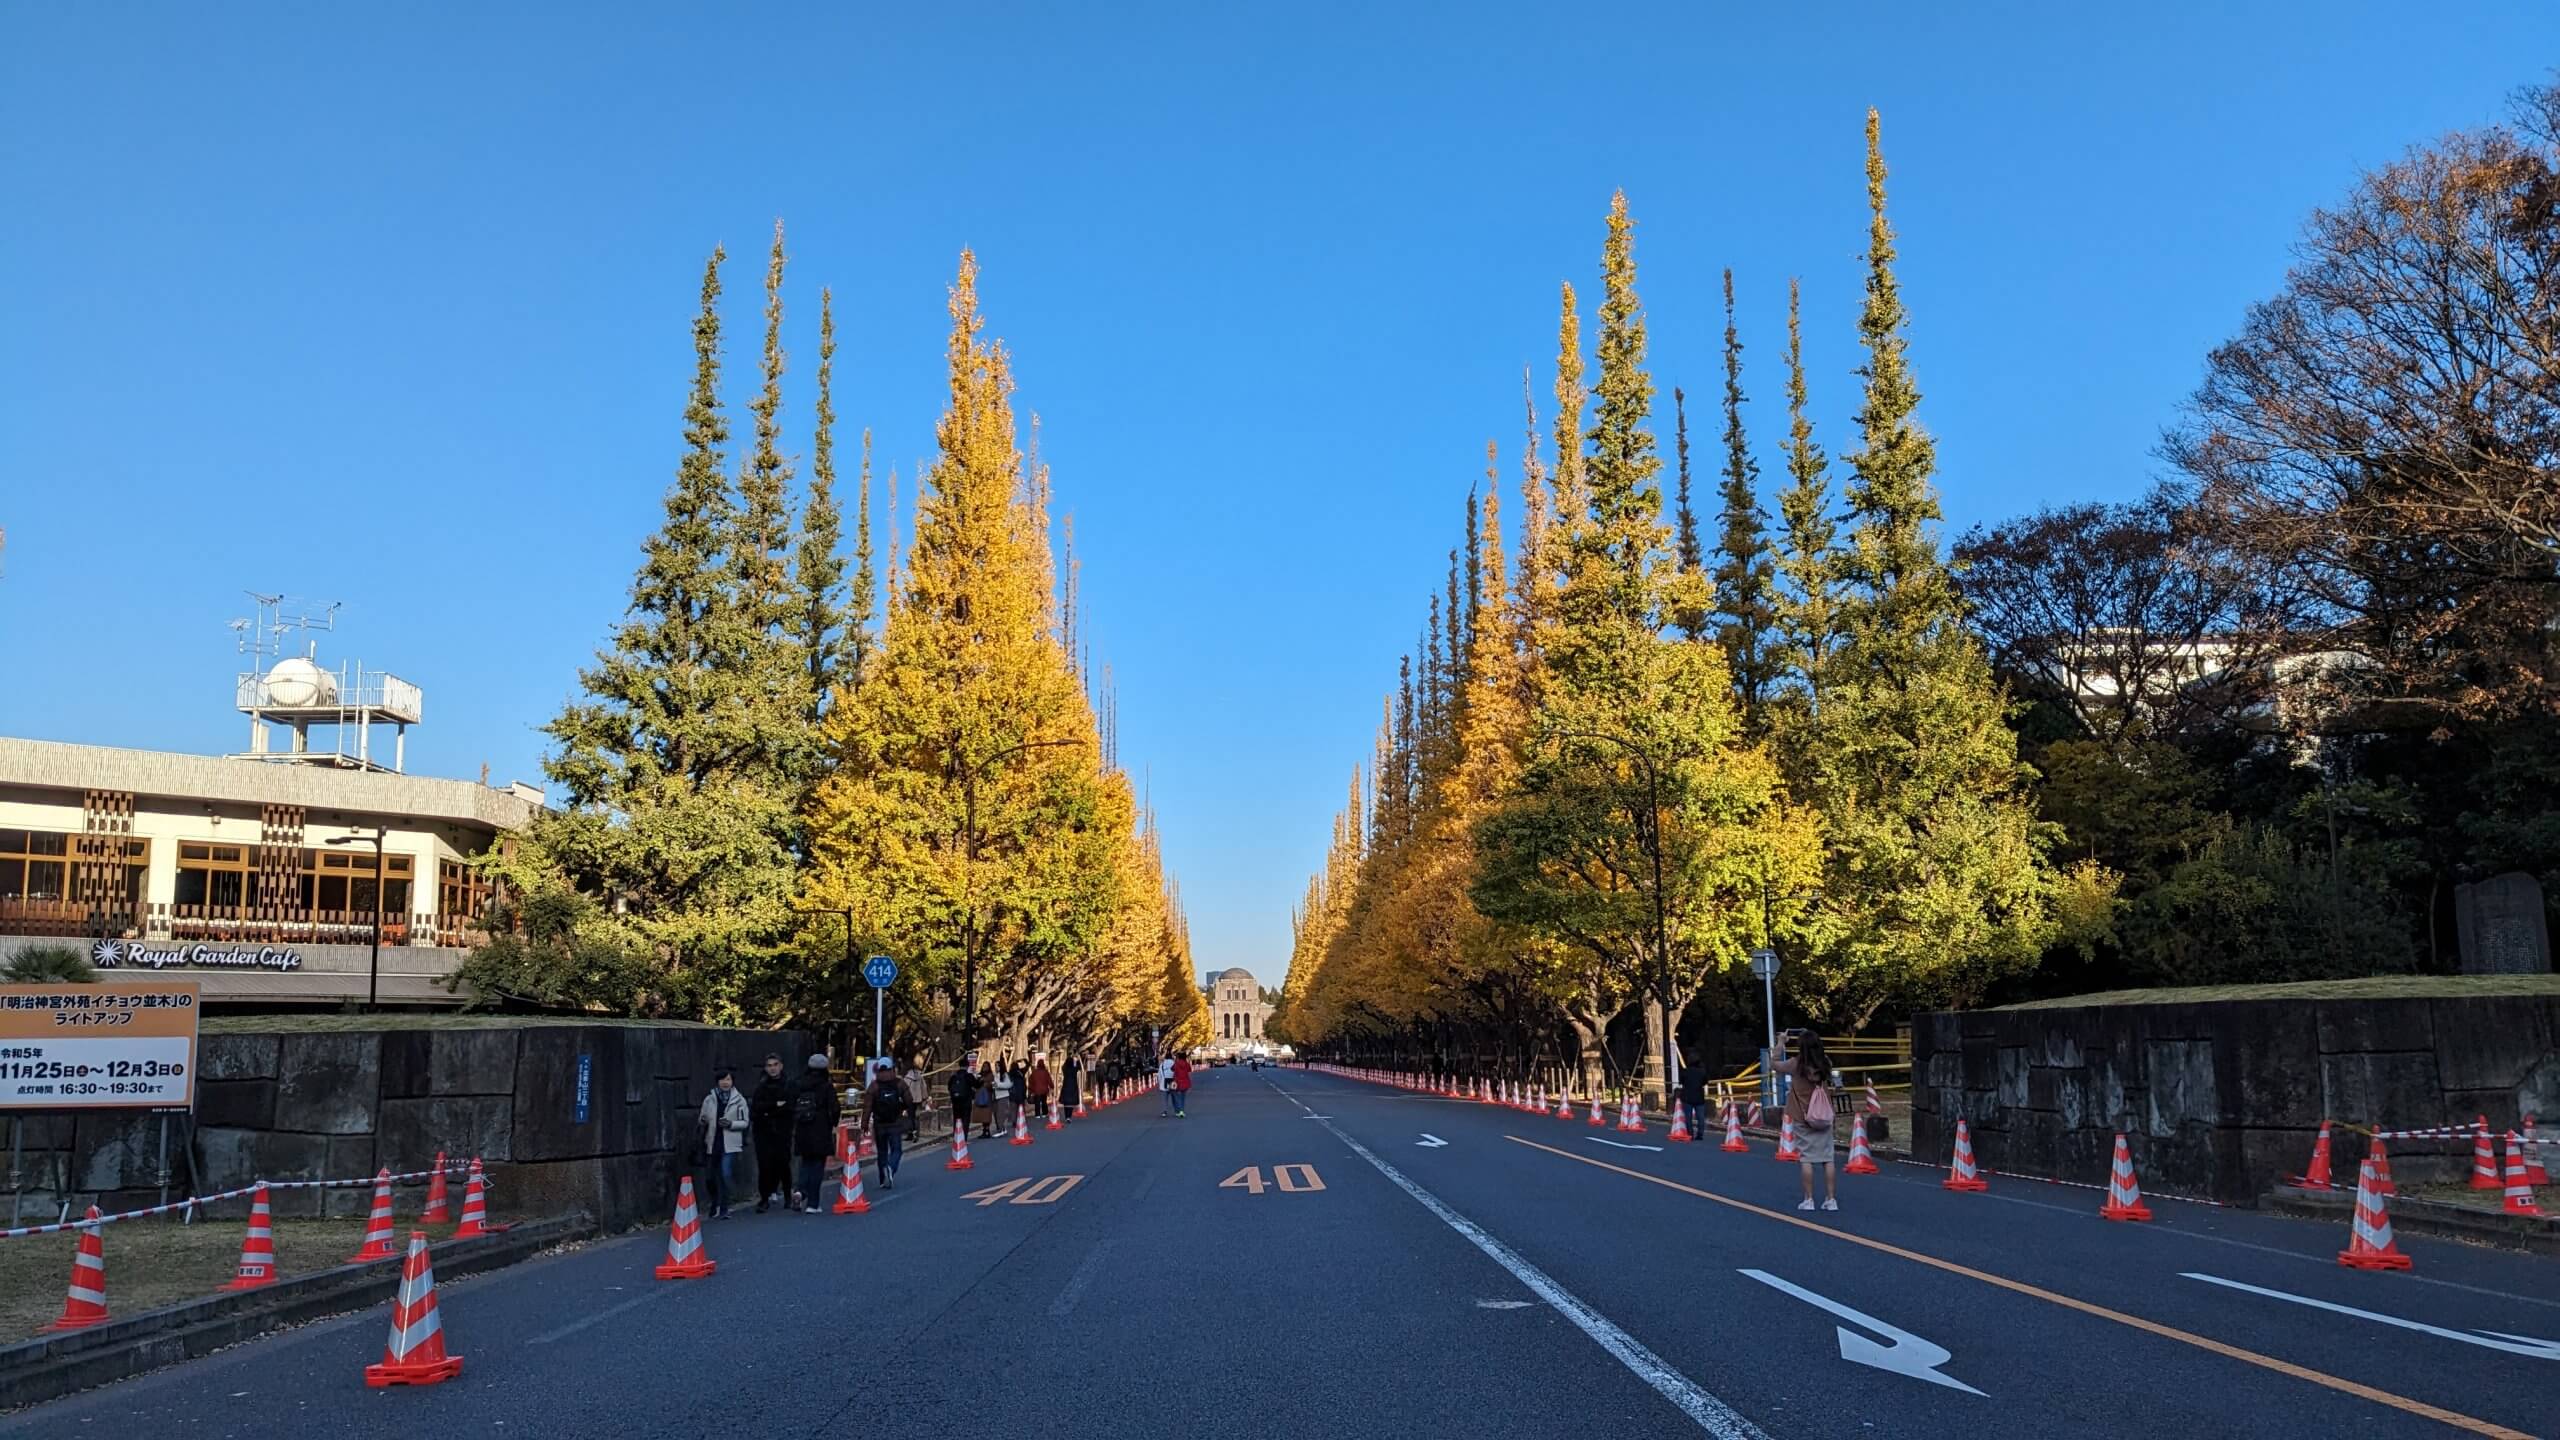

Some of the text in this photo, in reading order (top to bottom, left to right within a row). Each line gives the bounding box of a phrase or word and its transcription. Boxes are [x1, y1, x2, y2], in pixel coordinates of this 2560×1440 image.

[127, 943, 301, 970] Royal Garden Cafe
[869, 965, 892, 977] 414
[0, 994, 192, 1010] 「明治神宮外苑イチョウ並木」の
[55, 1012, 133, 1026] ライトアップ
[0, 1047, 43, 1059] 令和5年
[1219, 1164, 1327, 1194] 40
[960, 1174, 1085, 1206] 40
